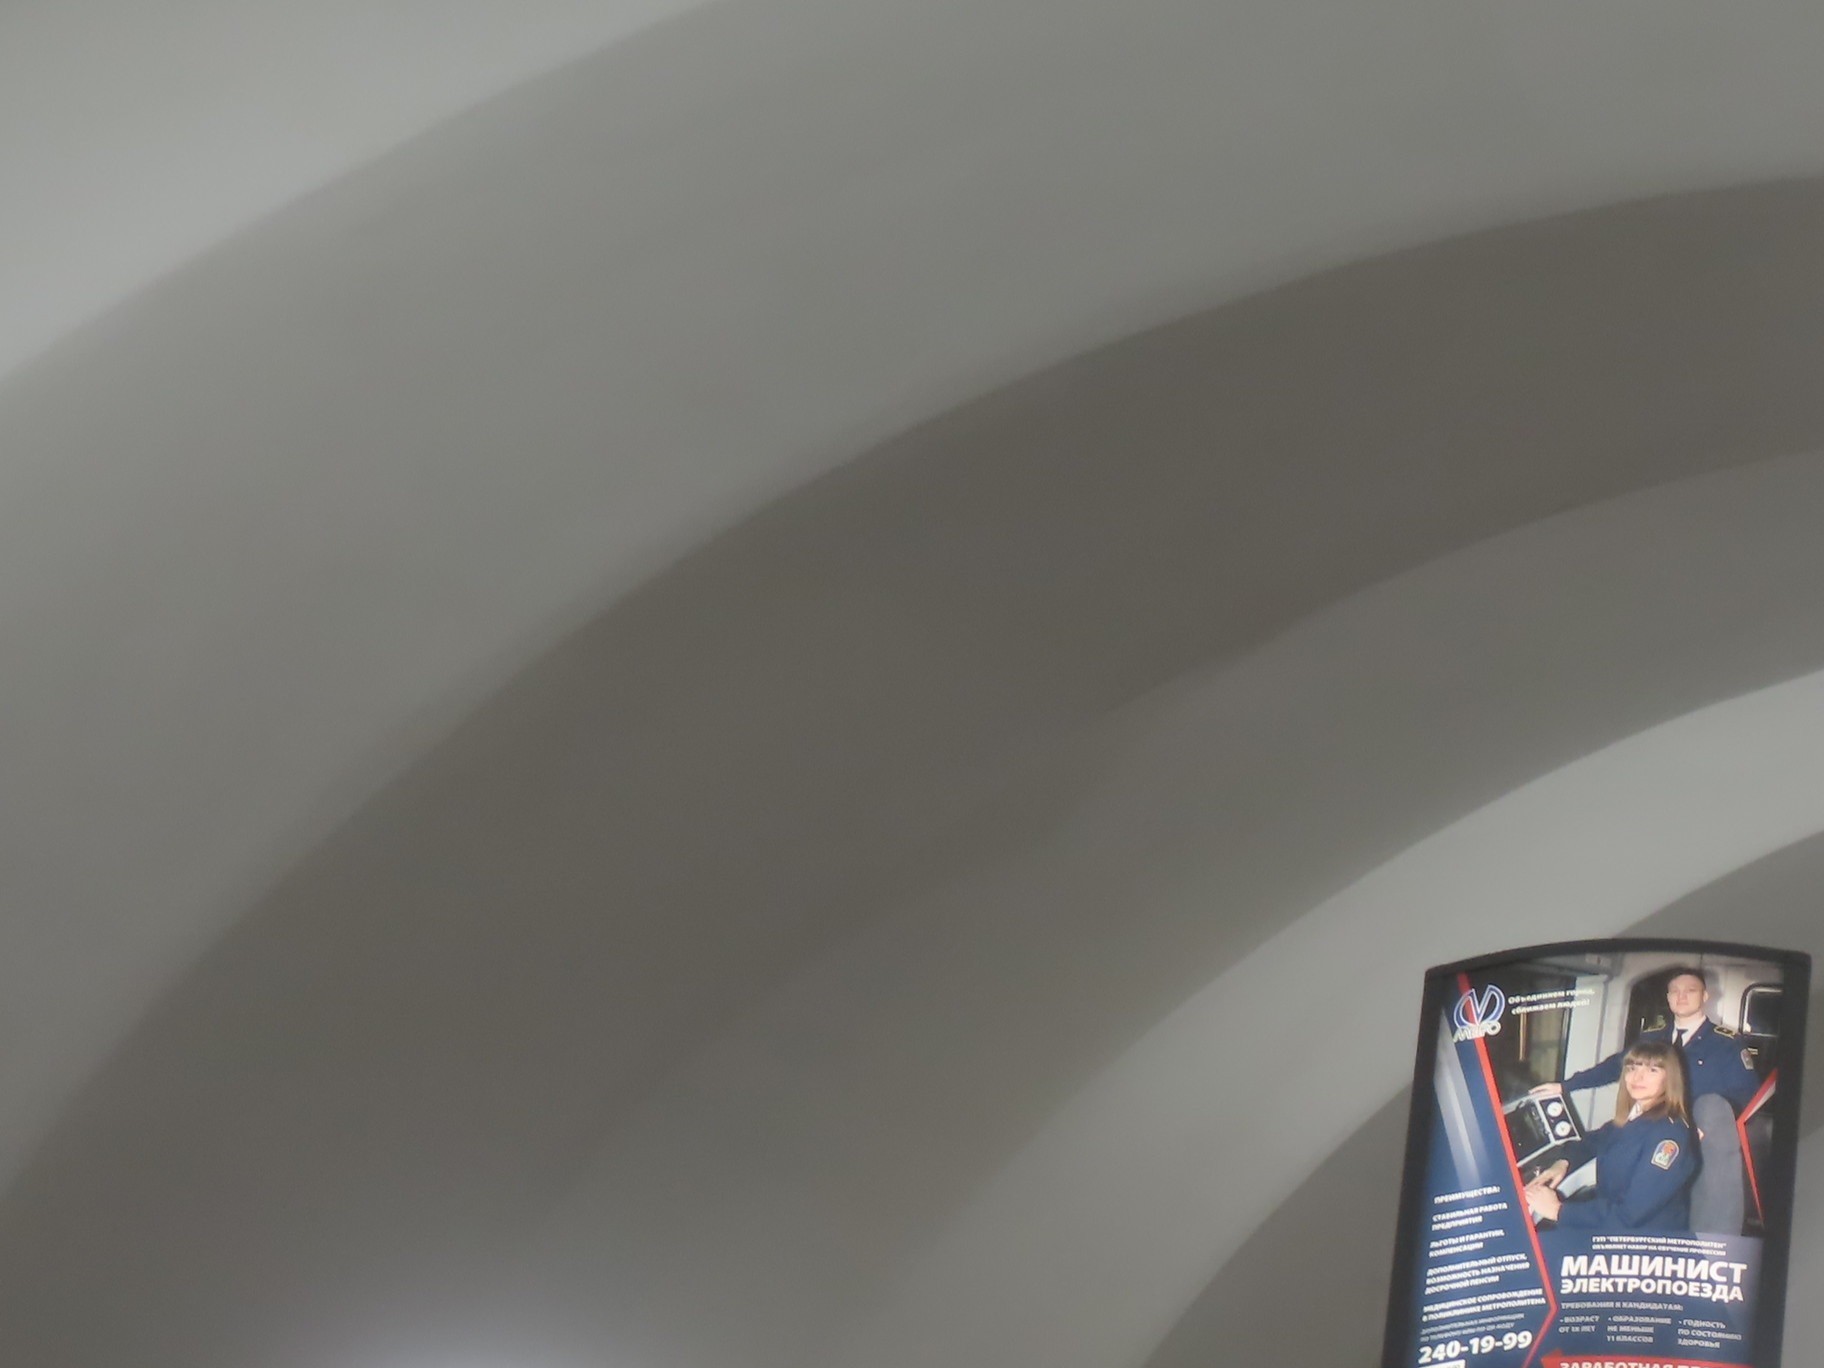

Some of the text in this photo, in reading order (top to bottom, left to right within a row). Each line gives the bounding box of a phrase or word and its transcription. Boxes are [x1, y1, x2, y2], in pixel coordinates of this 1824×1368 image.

[1560, 1255, 1747, 1284] МАШИНИСТ
[1560, 1278, 1744, 1303] ЭЛЕКТРОПОЕЗДА
[1418, 1330, 1533, 1364] 240-19-99
